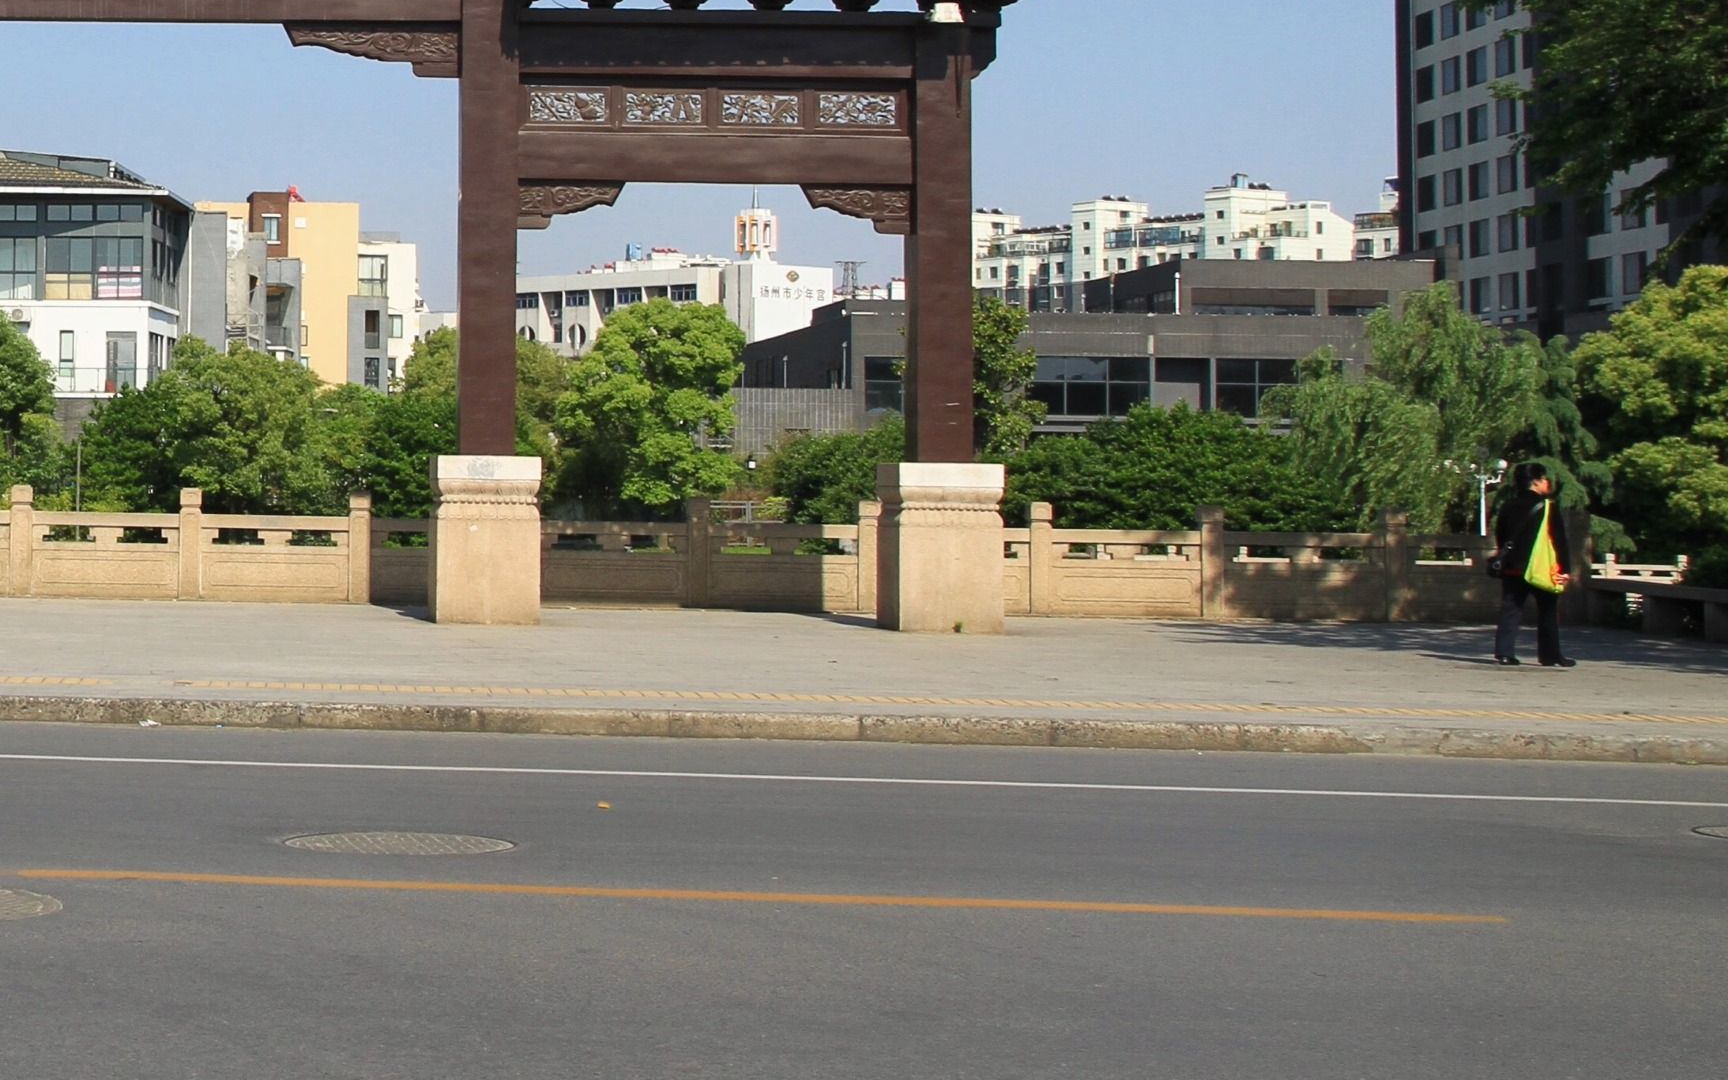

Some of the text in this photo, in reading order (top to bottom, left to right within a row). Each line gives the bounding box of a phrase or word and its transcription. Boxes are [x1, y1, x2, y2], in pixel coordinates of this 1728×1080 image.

[759, 285, 826, 302] 扬州市少年宫
